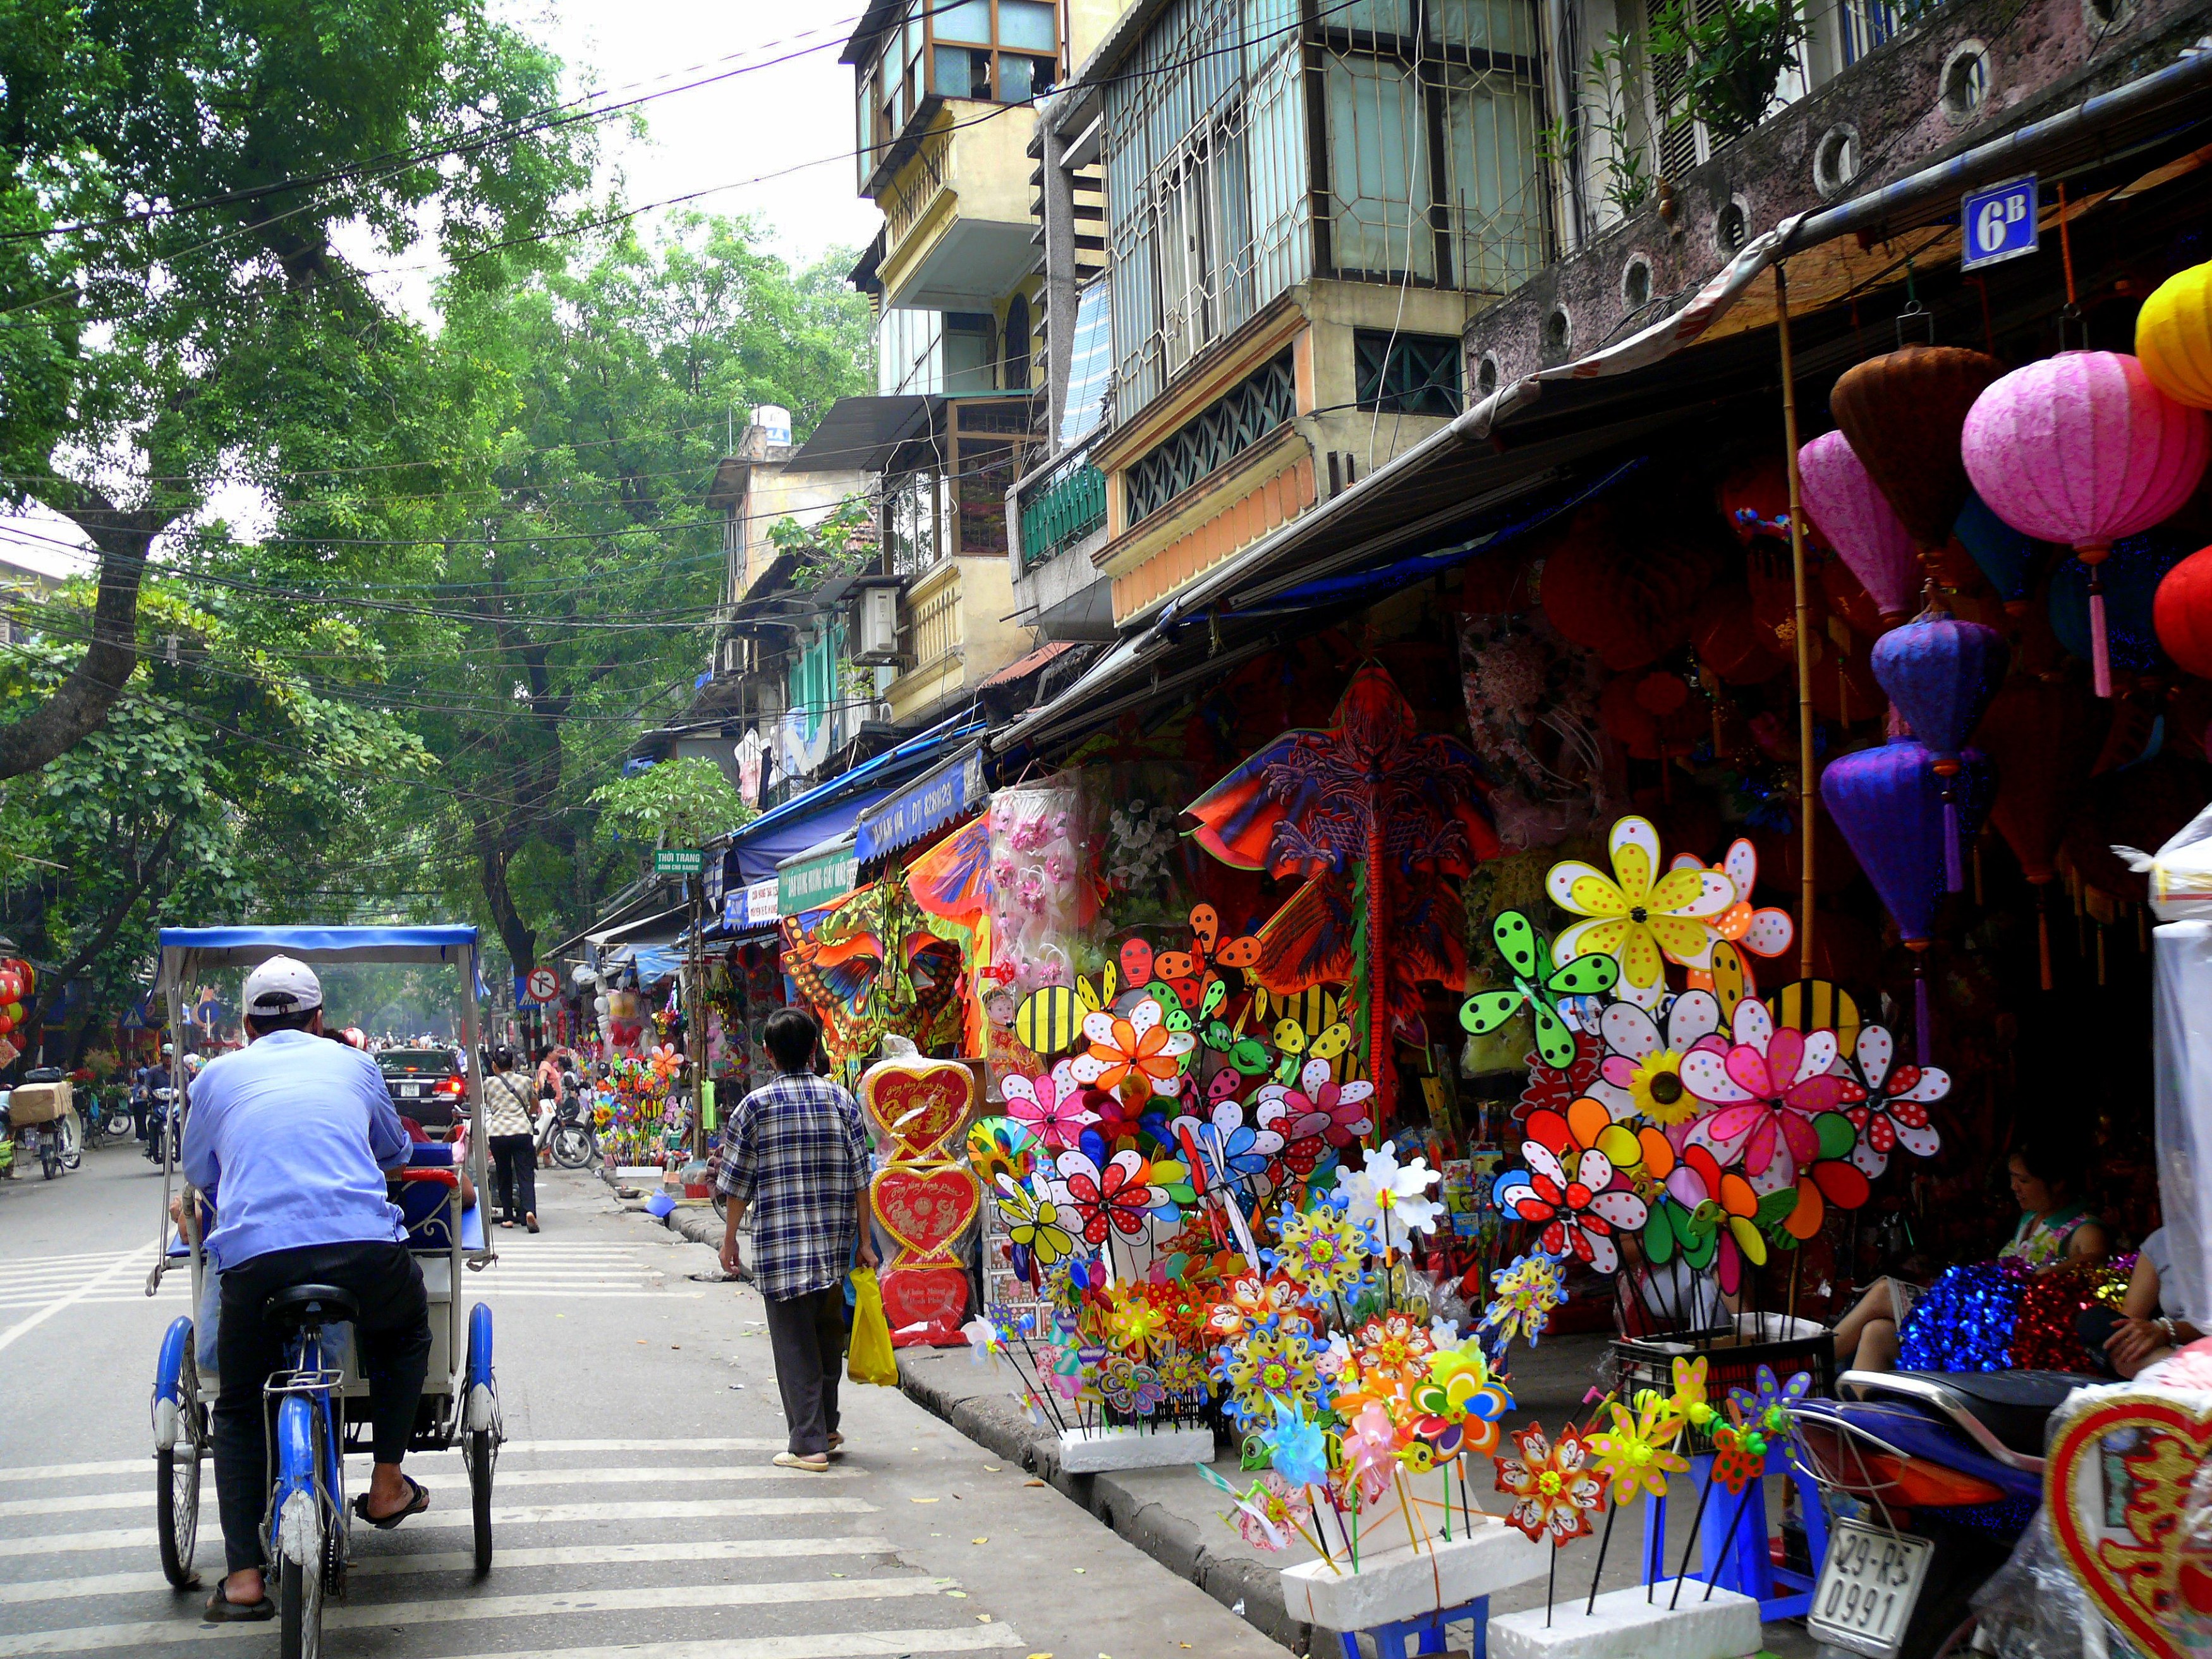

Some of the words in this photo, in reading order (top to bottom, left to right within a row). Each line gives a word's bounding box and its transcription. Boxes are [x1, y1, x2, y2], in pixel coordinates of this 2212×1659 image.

[1977, 194, 2027, 252] 6B
[676, 853, 700, 863] TRANG
[1825, 1578, 1897, 1634] 0991
